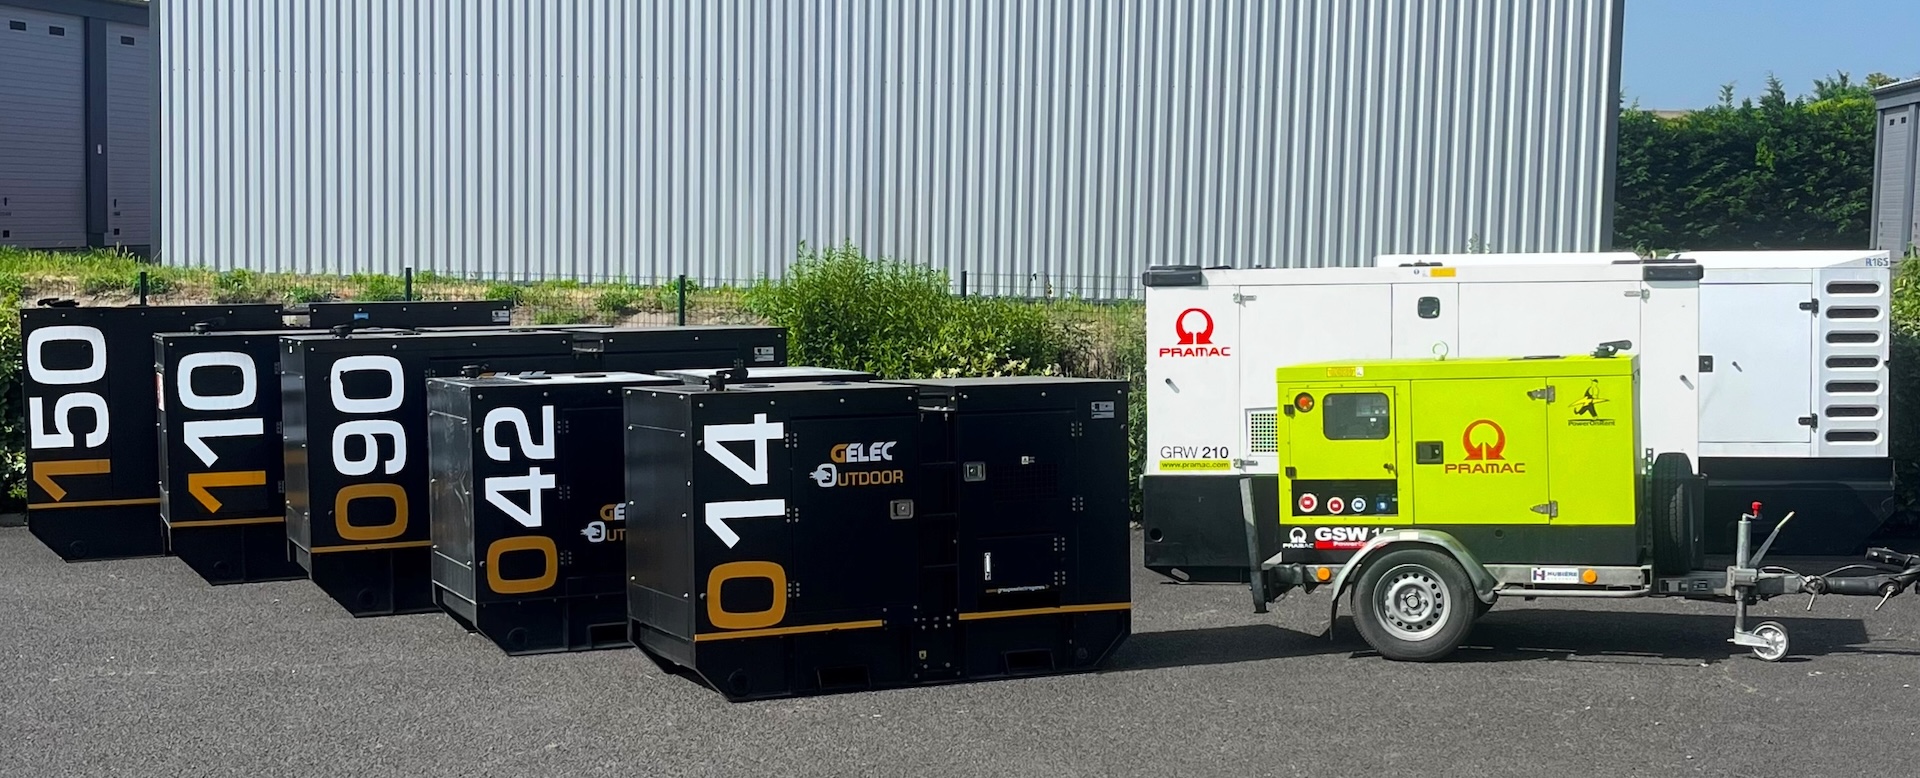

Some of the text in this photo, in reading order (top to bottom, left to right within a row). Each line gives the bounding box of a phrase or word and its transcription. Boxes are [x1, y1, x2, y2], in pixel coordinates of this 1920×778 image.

[1866, 257, 1889, 267] R165
[1159, 346, 1231, 357] PRAMAC
[27, 325, 111, 502] 150
[177, 351, 266, 514] 110
[330, 355, 409, 541] 090
[830, 441, 897, 463] GELEC
[1160, 445, 1229, 459] GRW 210
[1161, 461, 1229, 470] www.pramac.com
[1444, 462, 1526, 475] PRAMAC
[483, 405, 559, 594] 042
[704, 413, 787, 630] 014
[1314, 526, 1369, 542] GSW
